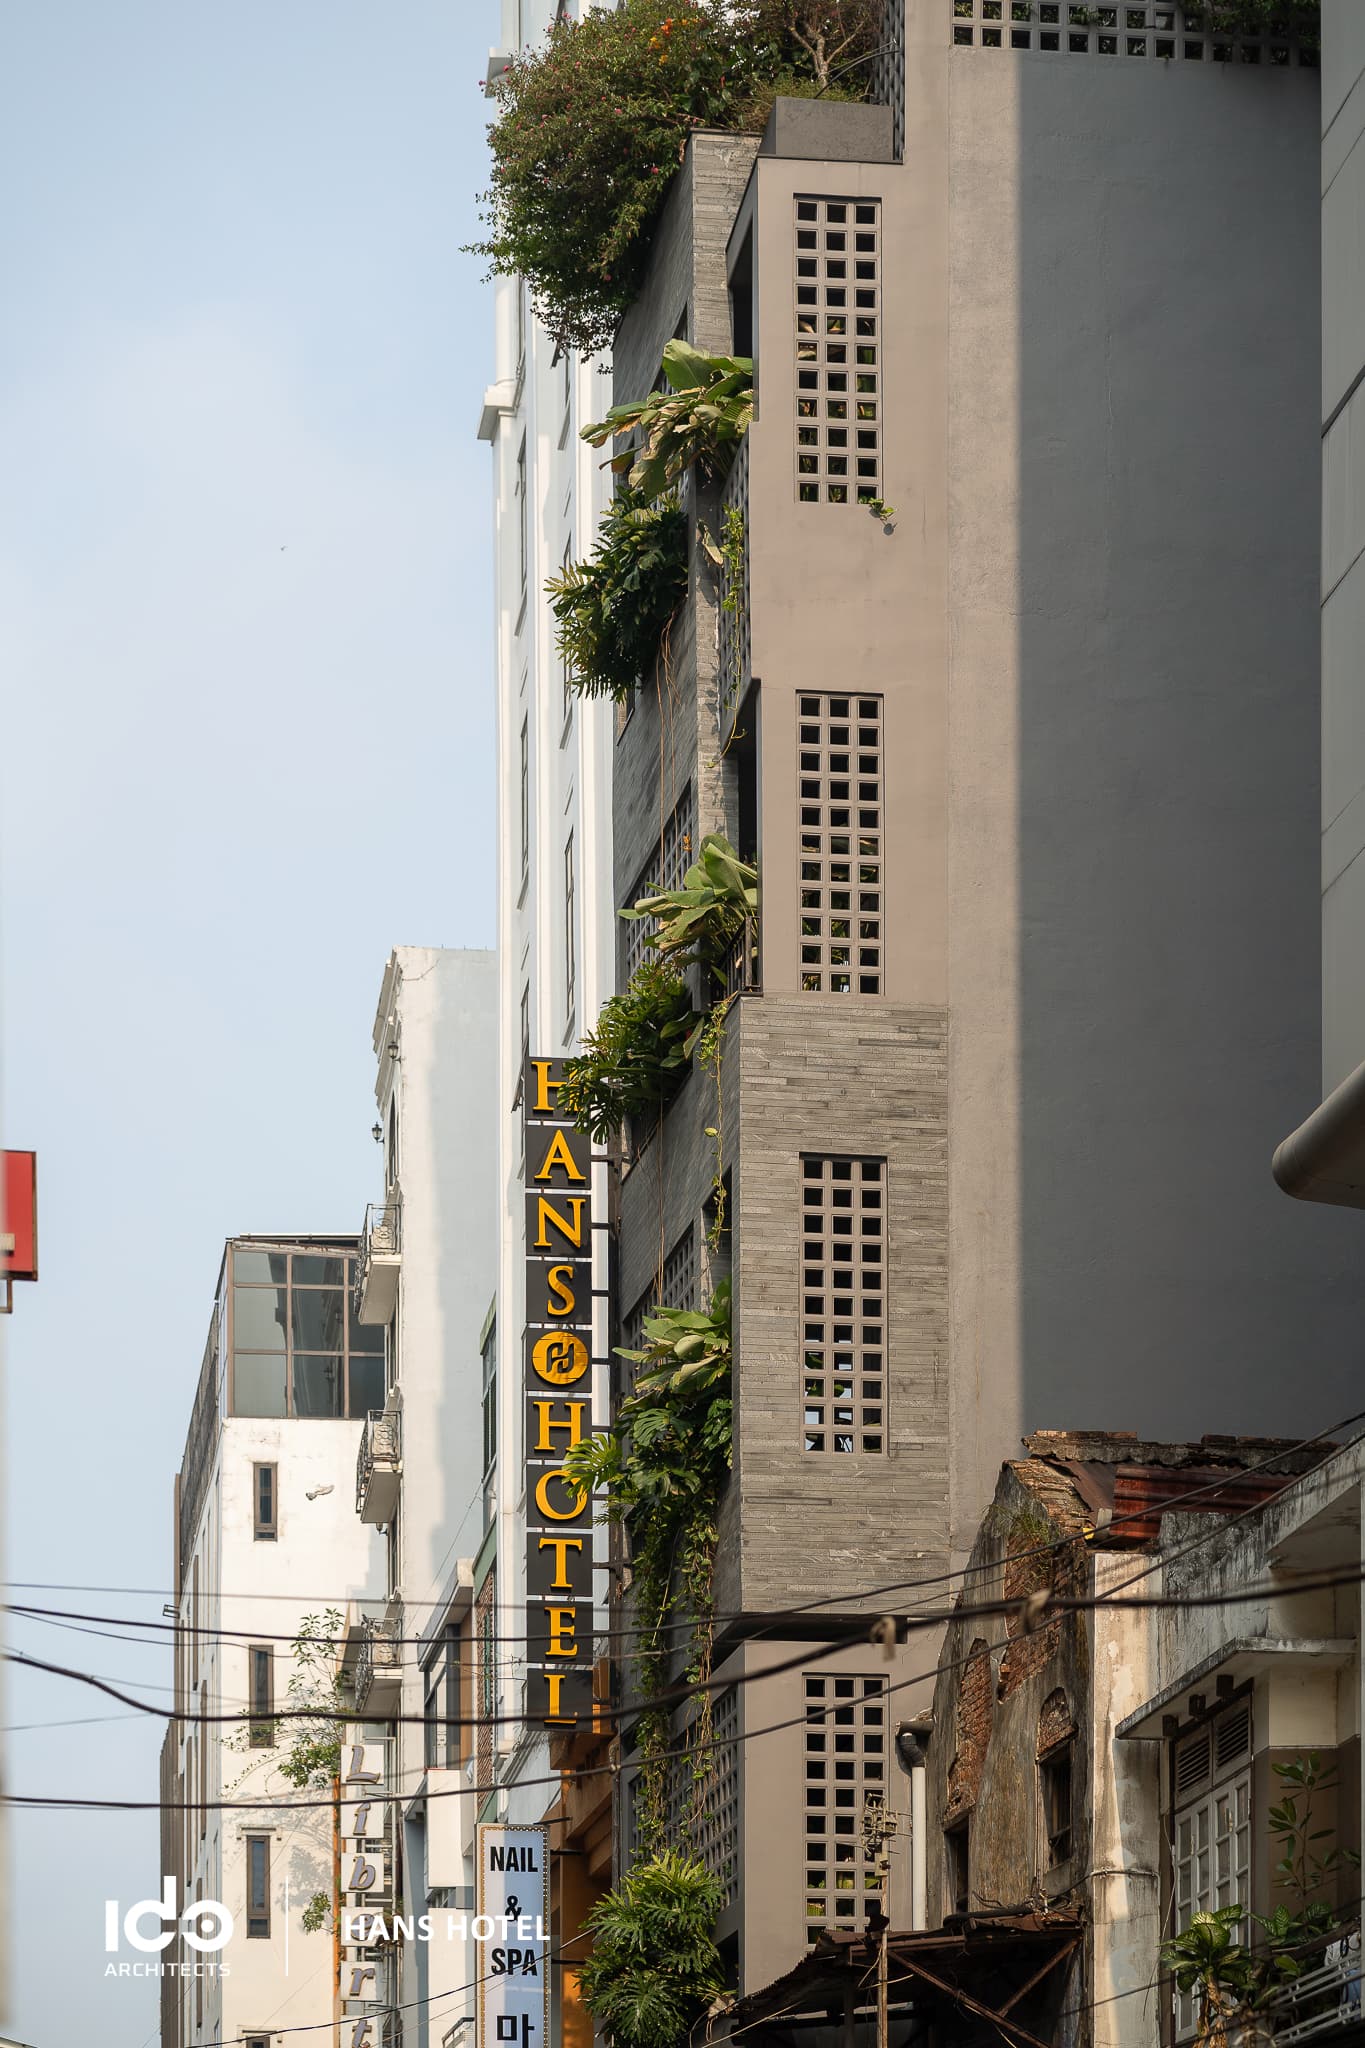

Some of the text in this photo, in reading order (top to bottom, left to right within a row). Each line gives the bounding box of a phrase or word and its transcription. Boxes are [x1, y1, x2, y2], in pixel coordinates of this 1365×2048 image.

[531, 1061, 588, 1724] HANS HOTEL
[490, 1846, 538, 1873] NAIL
[505, 1895, 522, 1922] &
[491, 1948, 538, 1976] SPA
